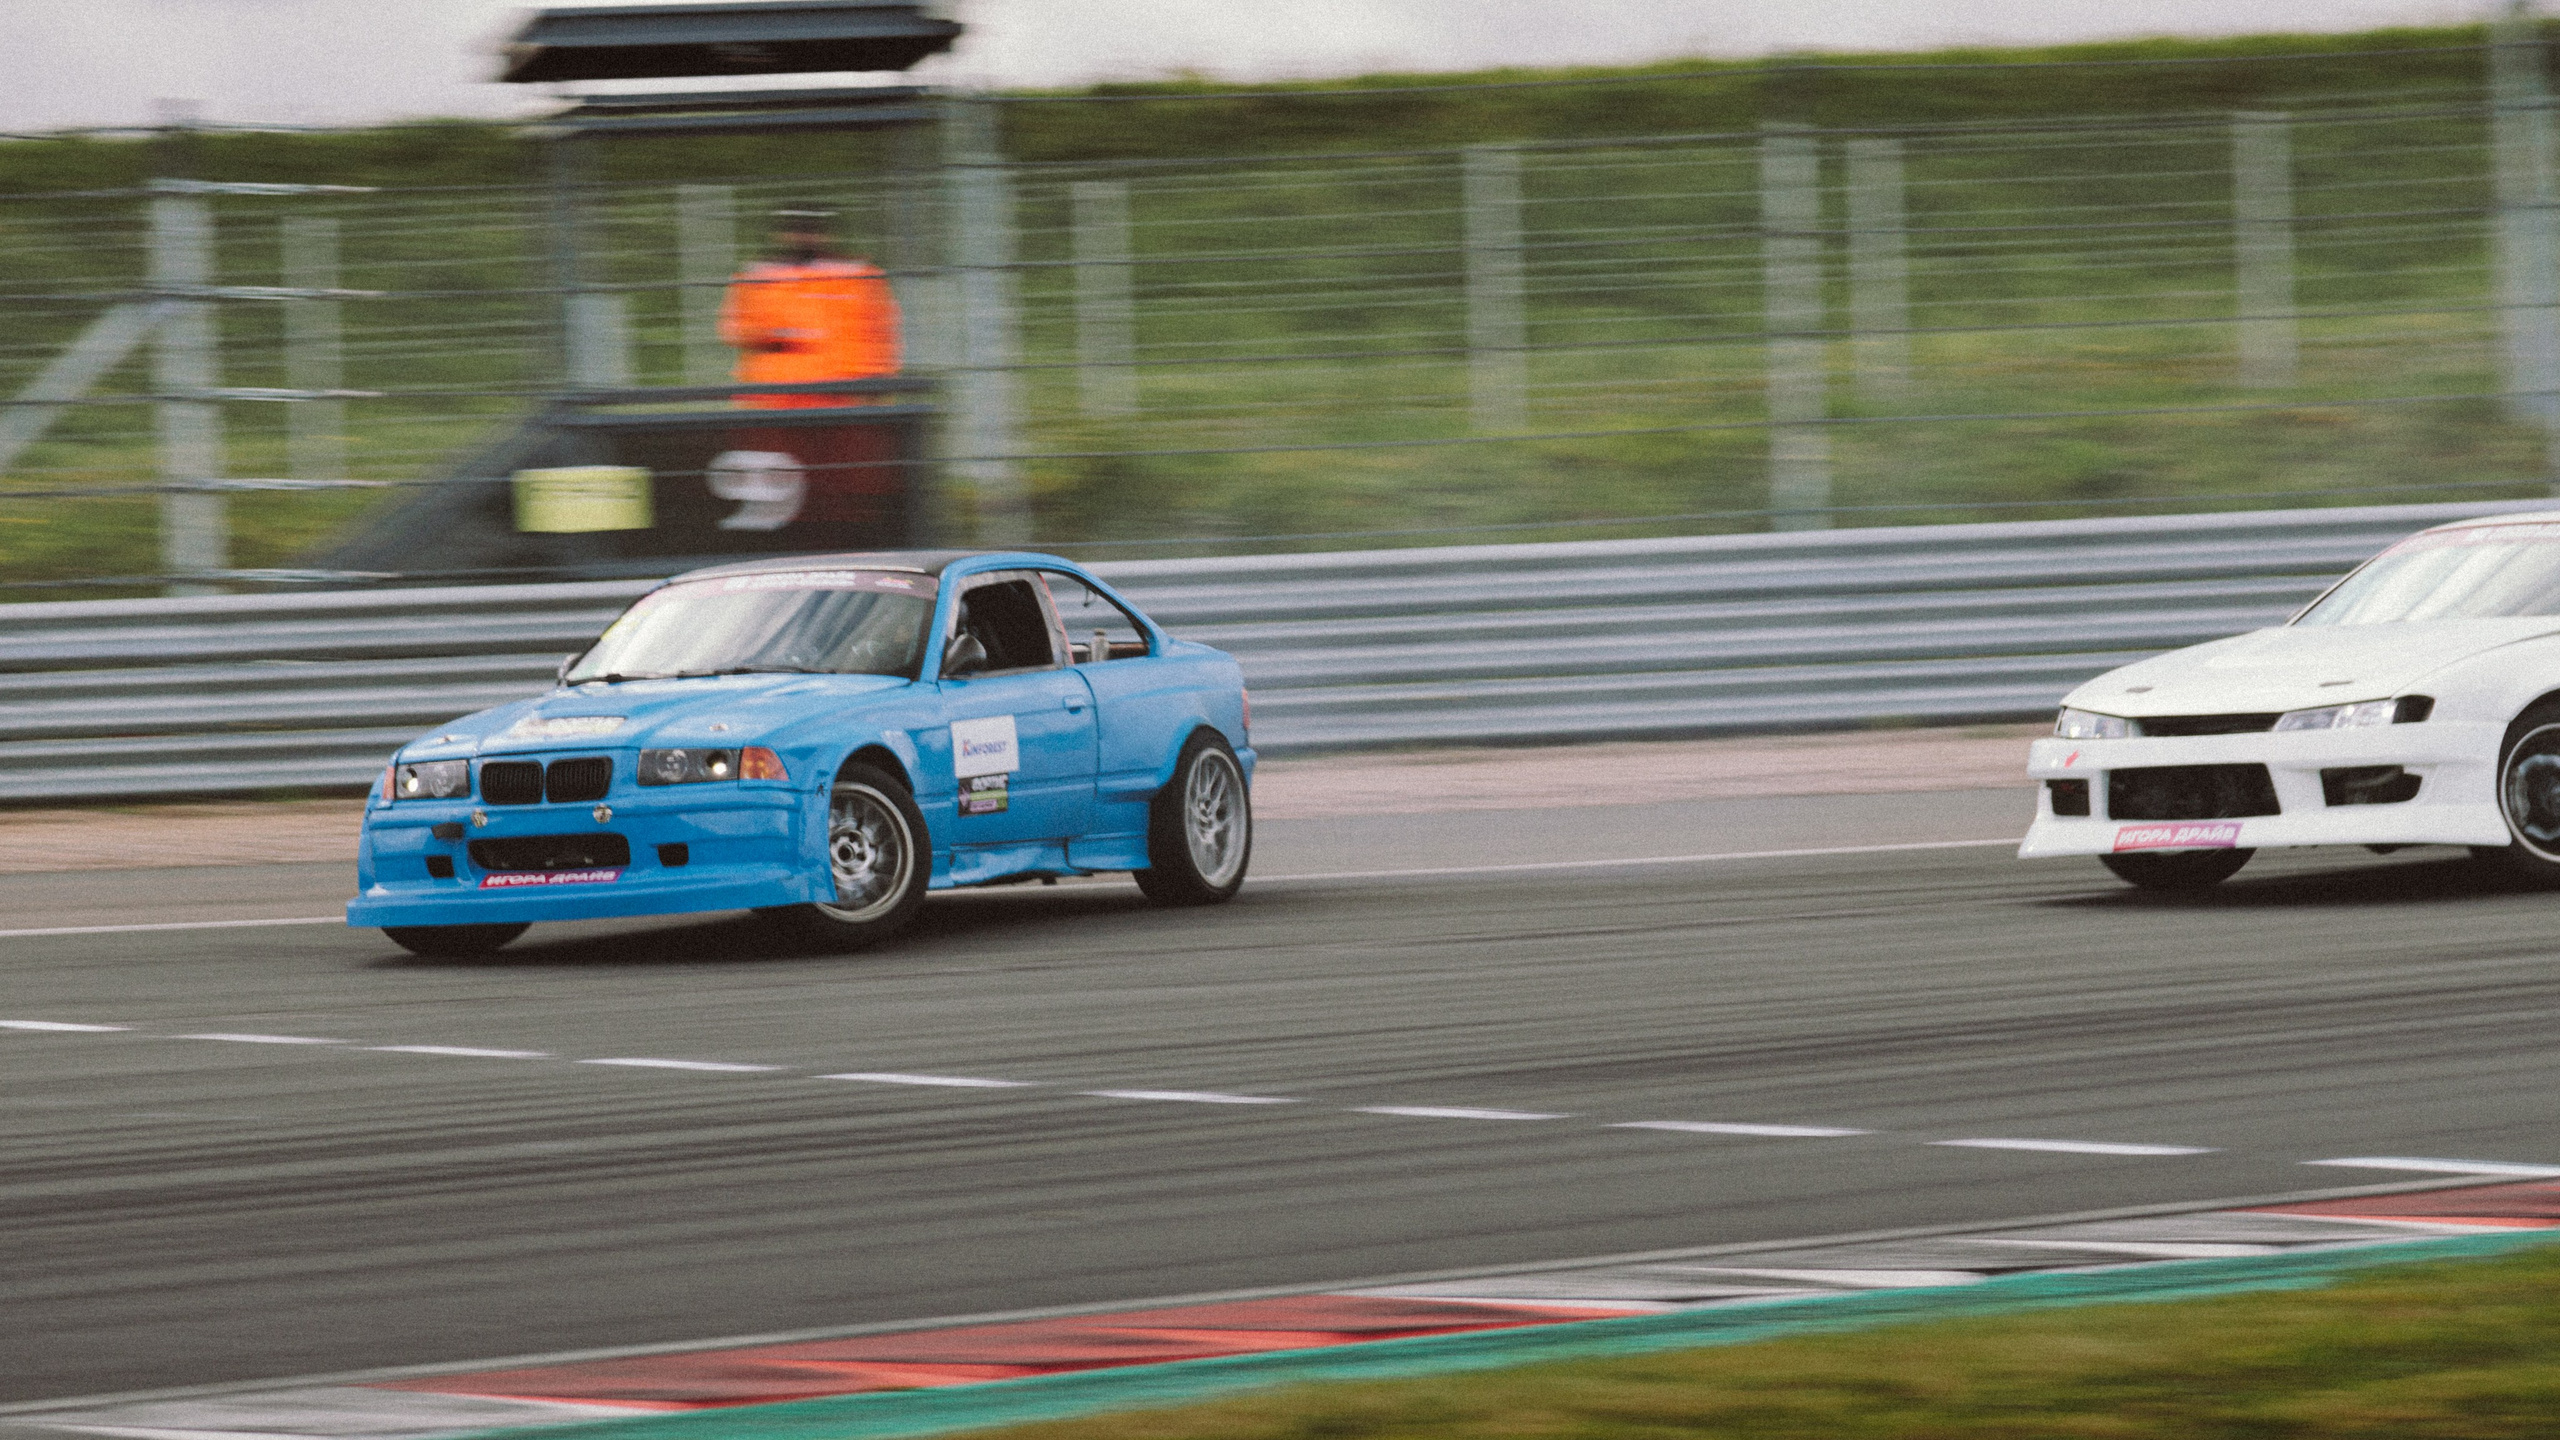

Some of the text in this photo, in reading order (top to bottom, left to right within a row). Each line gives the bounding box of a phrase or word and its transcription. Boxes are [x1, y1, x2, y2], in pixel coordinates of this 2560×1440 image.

[708, 450, 806, 530] 9
[2118, 824, 2236, 845] ИГОРА ДРАЙВ
[486, 870, 616, 886] ИГОРА ДРАЙВ
